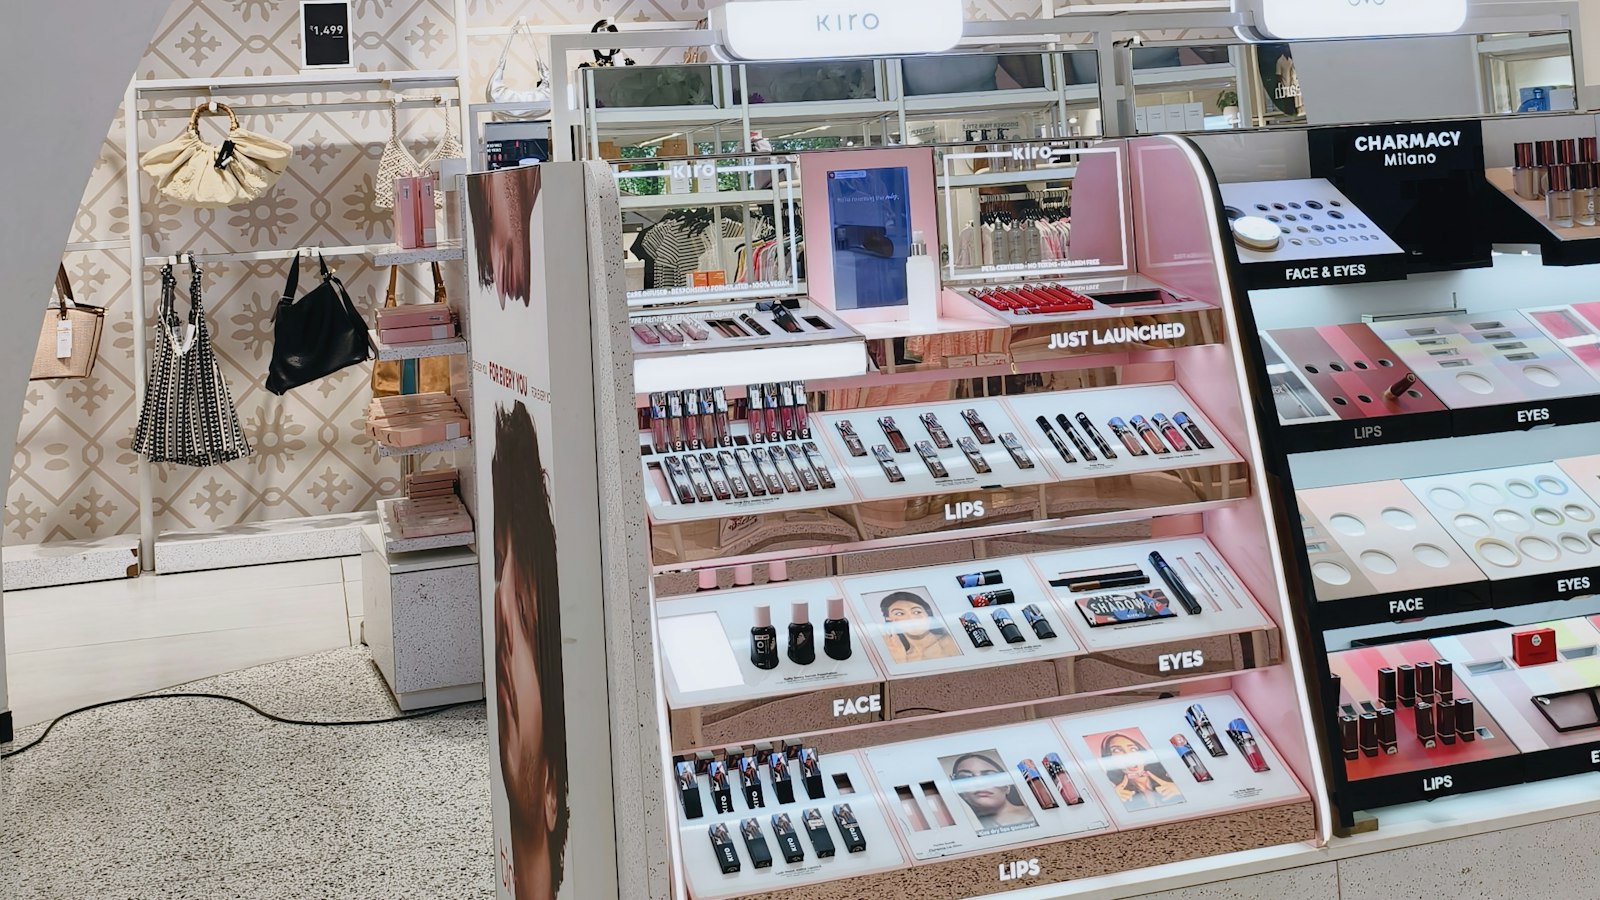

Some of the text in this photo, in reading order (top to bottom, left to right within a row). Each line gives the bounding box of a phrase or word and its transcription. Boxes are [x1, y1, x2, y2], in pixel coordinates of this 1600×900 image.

[1354, 130, 1462, 152] CHARMACY
[1384, 152, 1436, 167] Milano
[1285, 263, 1366, 281] FACE & EYES
[1048, 322, 1186, 349] JUST LAUNCHED
[489, 361, 500, 384] FOR
[499, 365, 515, 391] EVERY
[515, 371, 528, 397] YOU
[1517, 407, 1550, 423] EYES
[1354, 425, 1382, 440] LIPS
[944, 499, 985, 521] LIPS
[1557, 576, 1591, 592] EYES
[1090, 597, 1145, 614] SHADOW
[1389, 597, 1424, 613] FACE
[1158, 650, 1204, 672] EYES
[832, 694, 881, 717] FACE
[1423, 775, 1453, 792] LIPS
[998, 858, 1041, 882] LIPS
